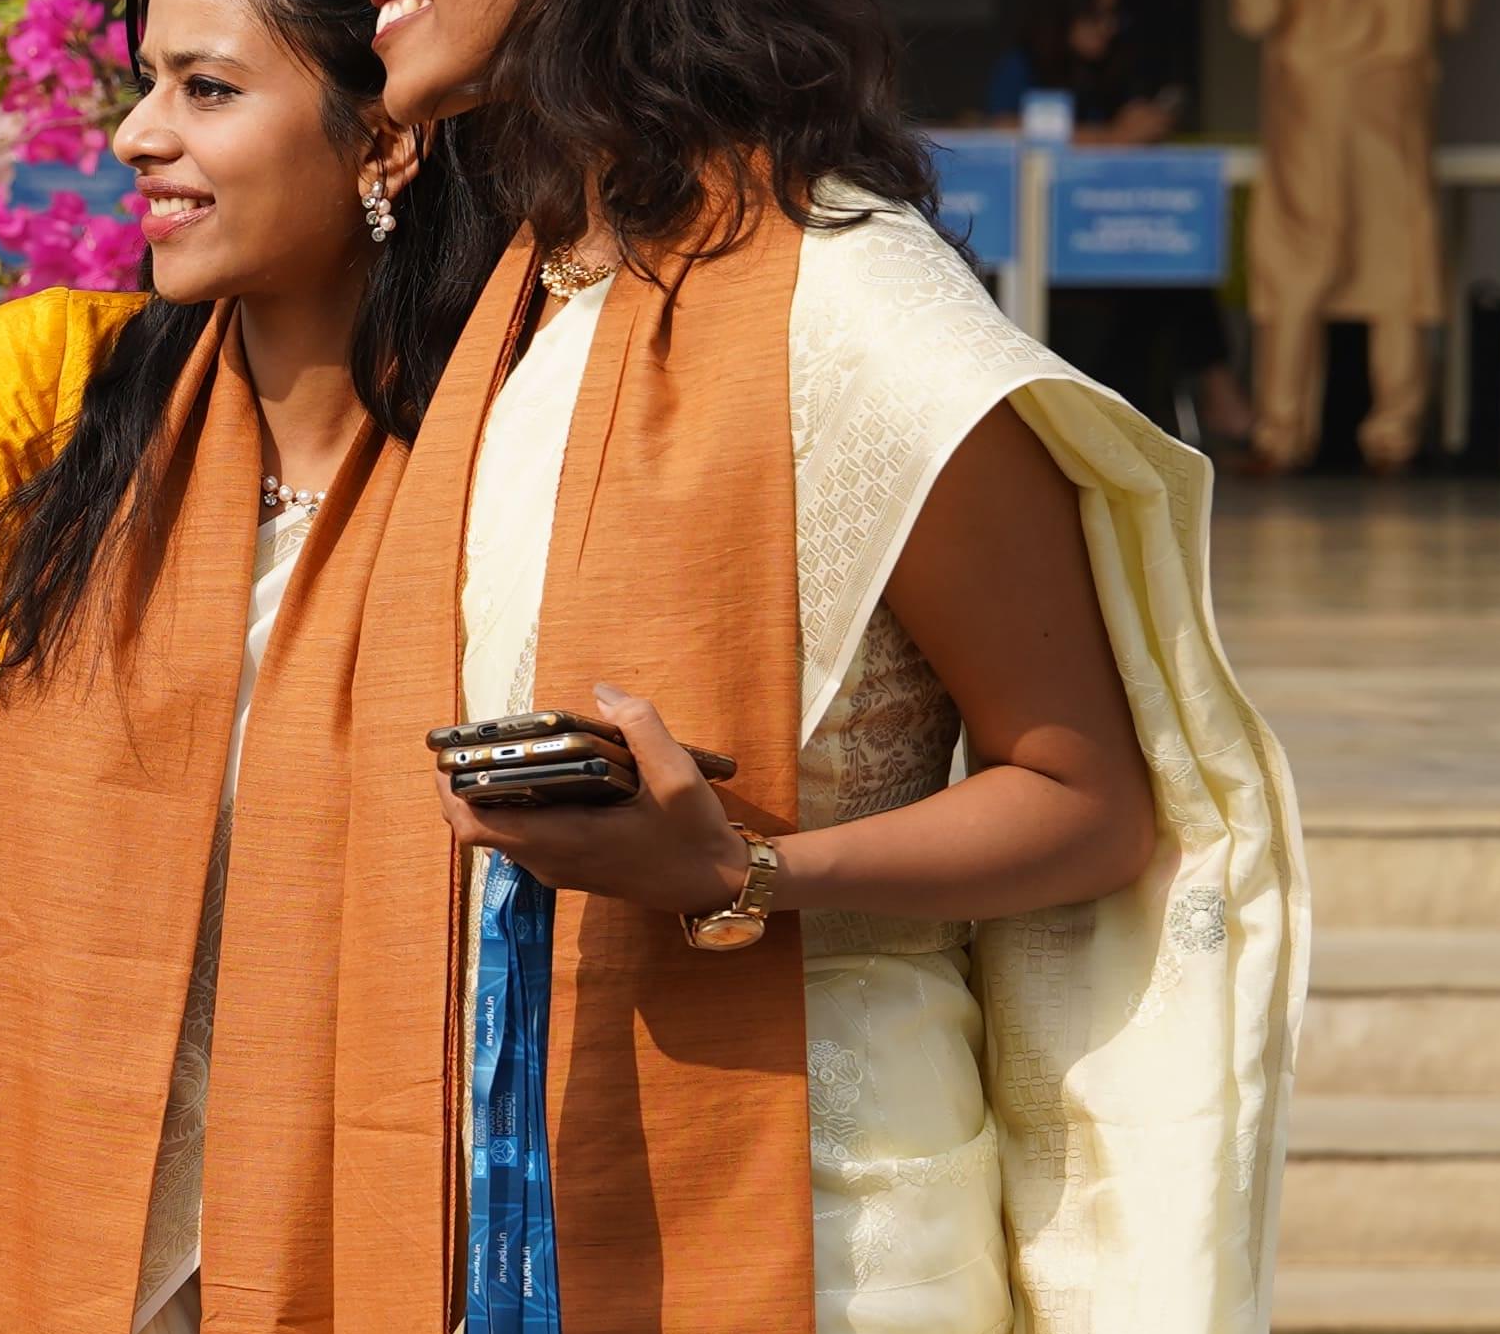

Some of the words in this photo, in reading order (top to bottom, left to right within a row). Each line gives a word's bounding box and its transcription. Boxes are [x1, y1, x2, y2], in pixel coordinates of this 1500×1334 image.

[485, 995, 495, 1047] anu.edu.in
[473, 1243, 481, 1295] anu.edu.in
[496, 1232, 507, 1283] anu.edu.in
[522, 1246, 533, 1297] anu.edu.in
